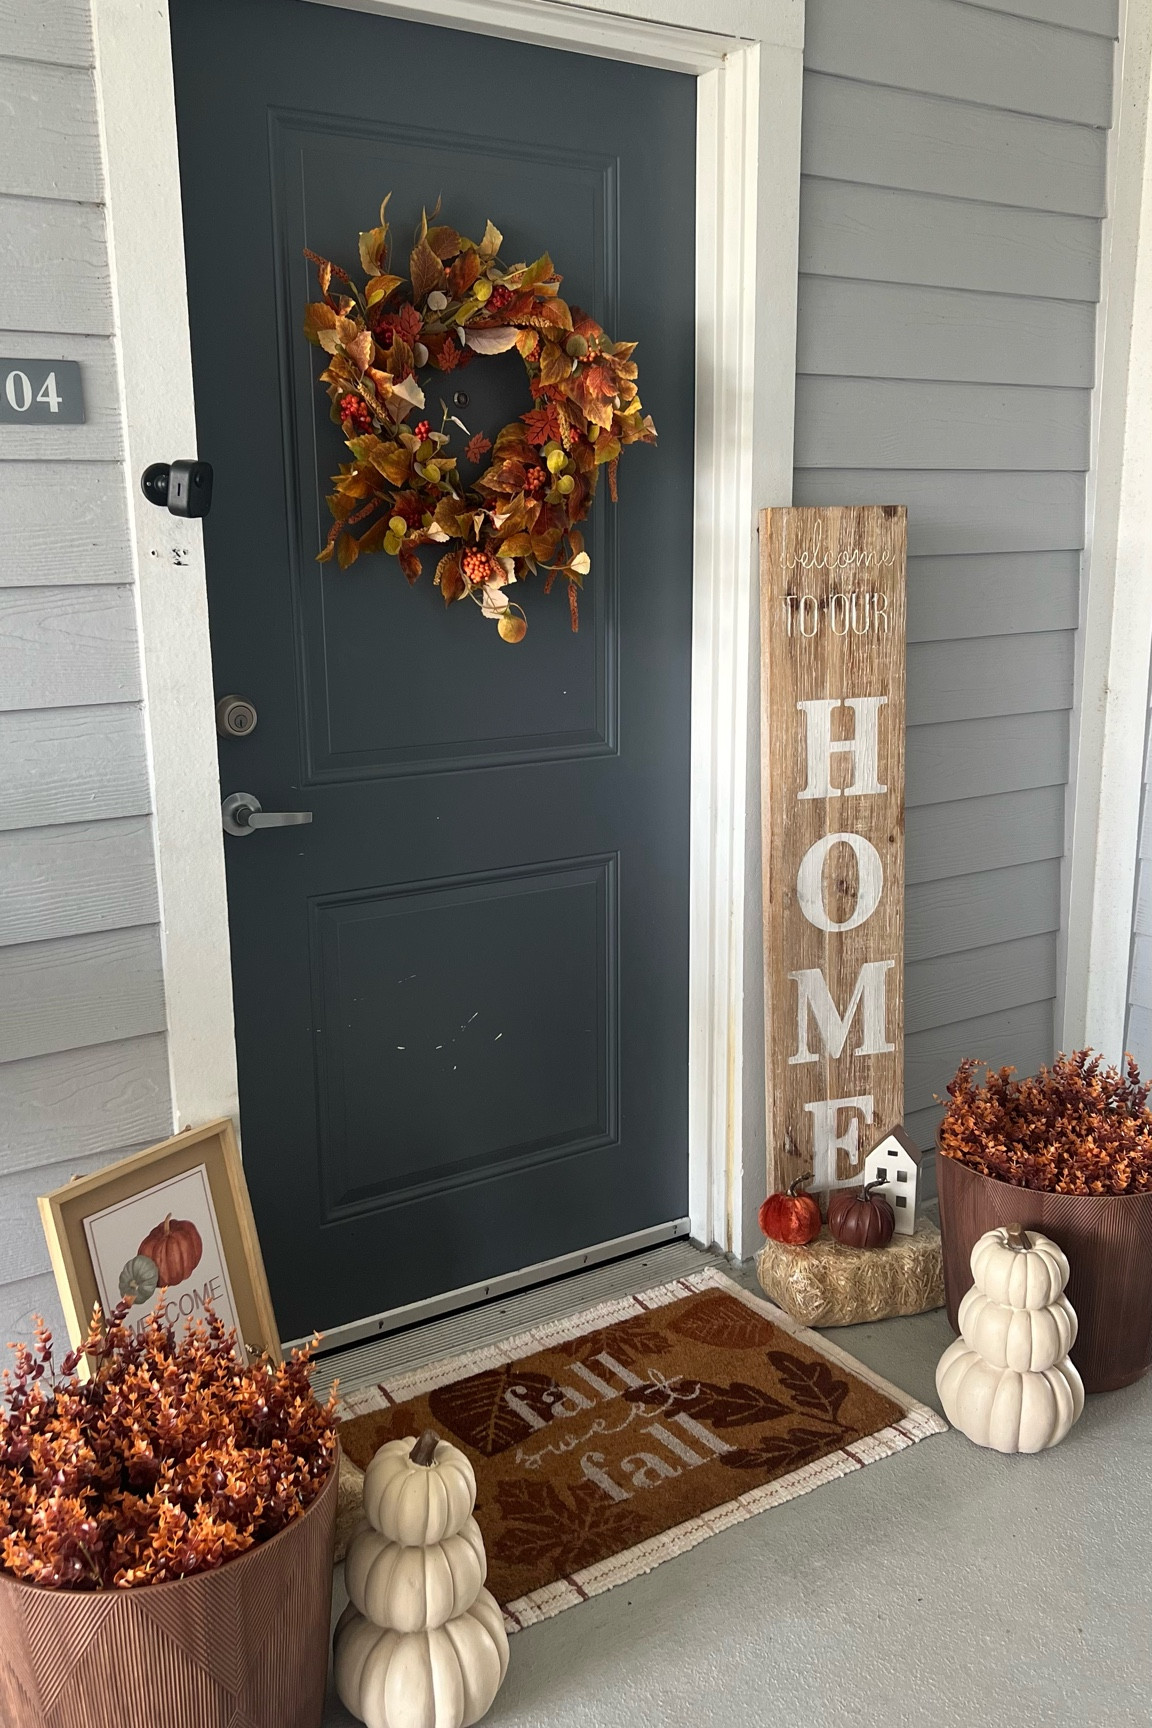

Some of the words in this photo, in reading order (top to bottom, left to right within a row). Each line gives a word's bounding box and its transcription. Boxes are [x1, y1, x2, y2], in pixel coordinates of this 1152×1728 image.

[5, 370, 63, 413] 04
[780, 519, 895, 569] welcome
[779, 595, 818, 637] TO
[830, 592, 888, 636] OUR
[788, 695, 896, 1192] HOME
[504, 1350, 652, 1433] fall
[515, 1368, 701, 1469] sweet
[579, 1411, 738, 1504] fall
